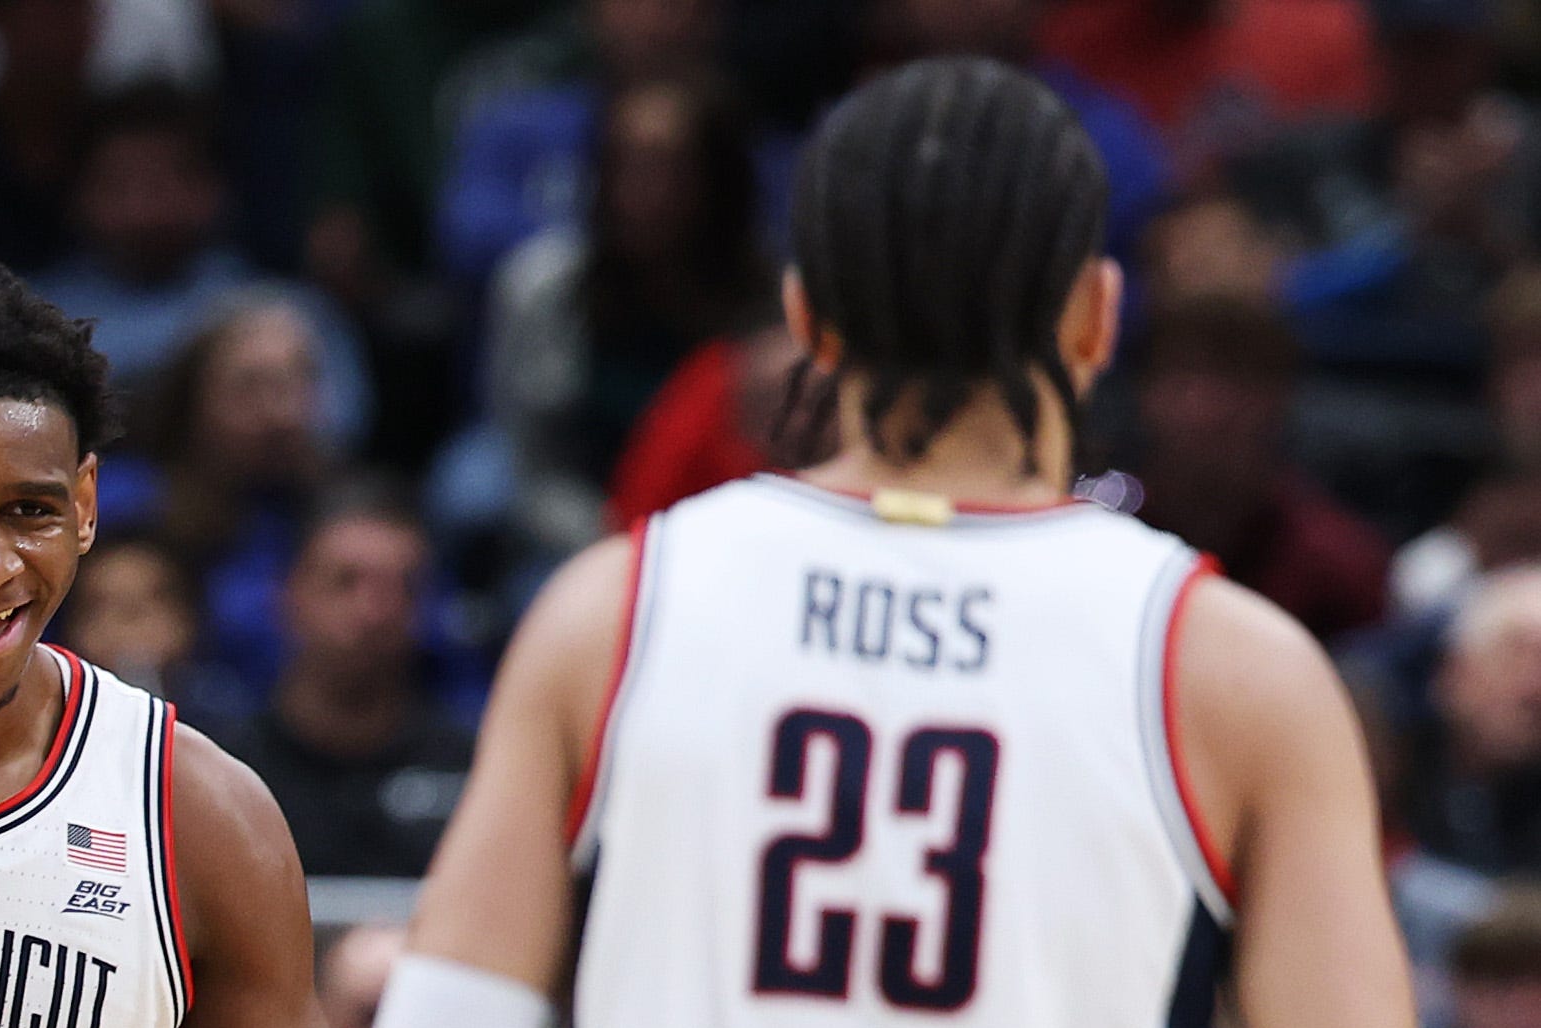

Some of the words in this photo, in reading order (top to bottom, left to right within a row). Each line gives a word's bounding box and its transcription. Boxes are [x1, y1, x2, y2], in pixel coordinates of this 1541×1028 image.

[801, 569, 995, 671] ROSS
[75, 880, 122, 898] BIG
[752, 705, 1001, 1014] 23
[67, 894, 131, 914] EAST
